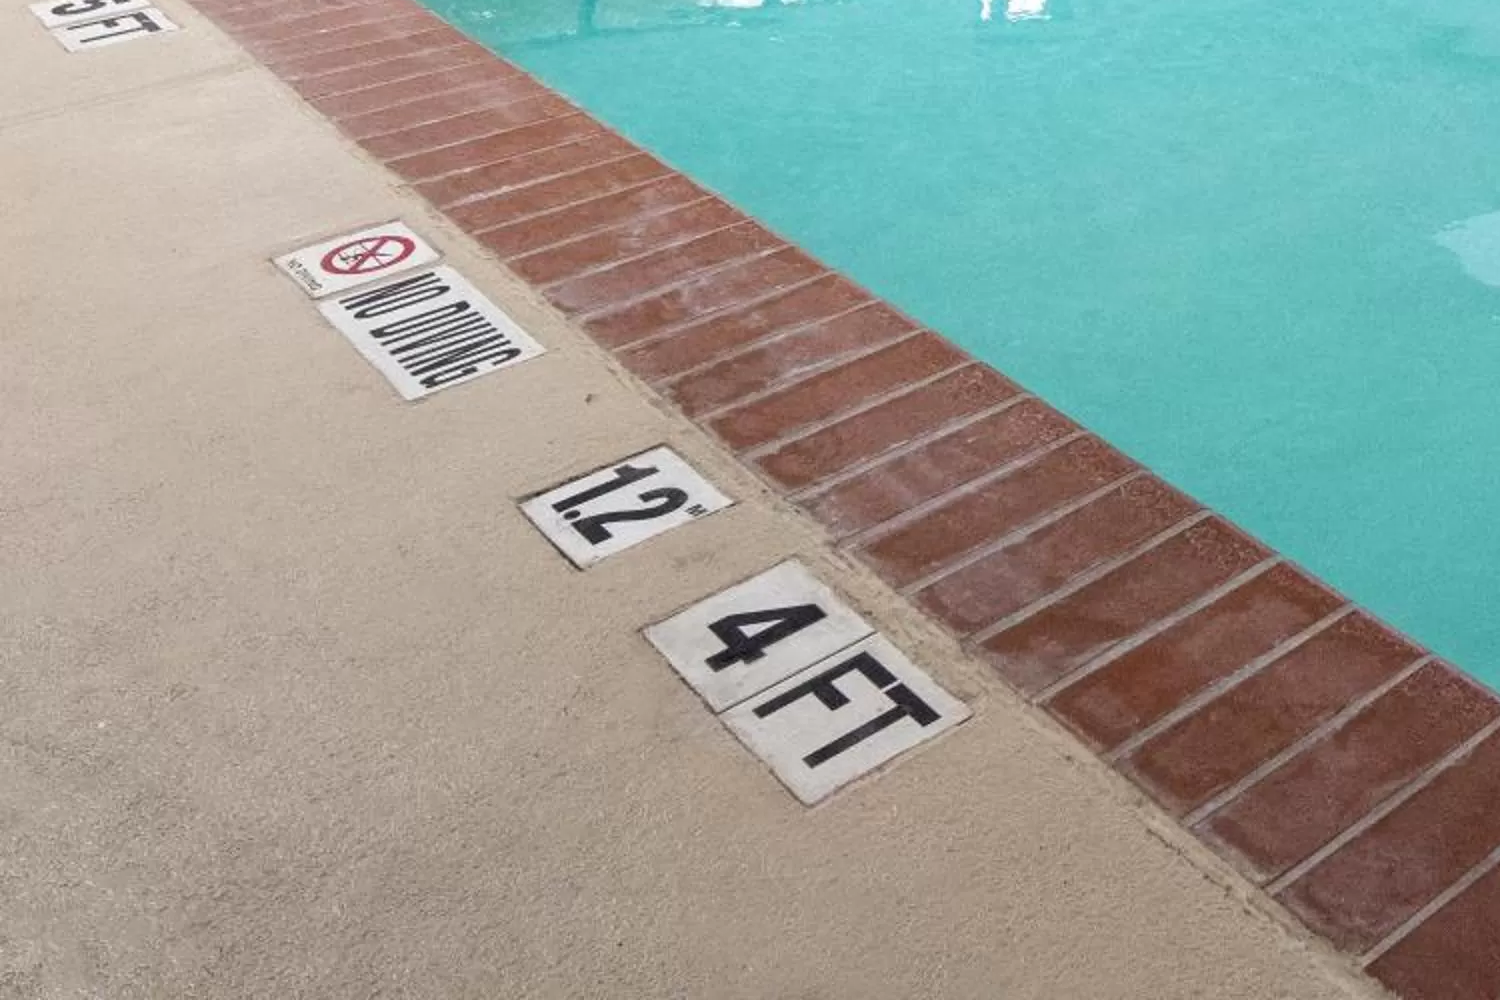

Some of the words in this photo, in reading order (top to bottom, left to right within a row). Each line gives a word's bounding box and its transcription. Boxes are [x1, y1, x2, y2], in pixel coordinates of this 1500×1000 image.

[66, 12, 162, 43] FT
[338, 272, 450, 319] NO
[369, 300, 522, 388] DIVING
[705, 603, 827, 673] 4
[752, 651, 942, 769] FT
